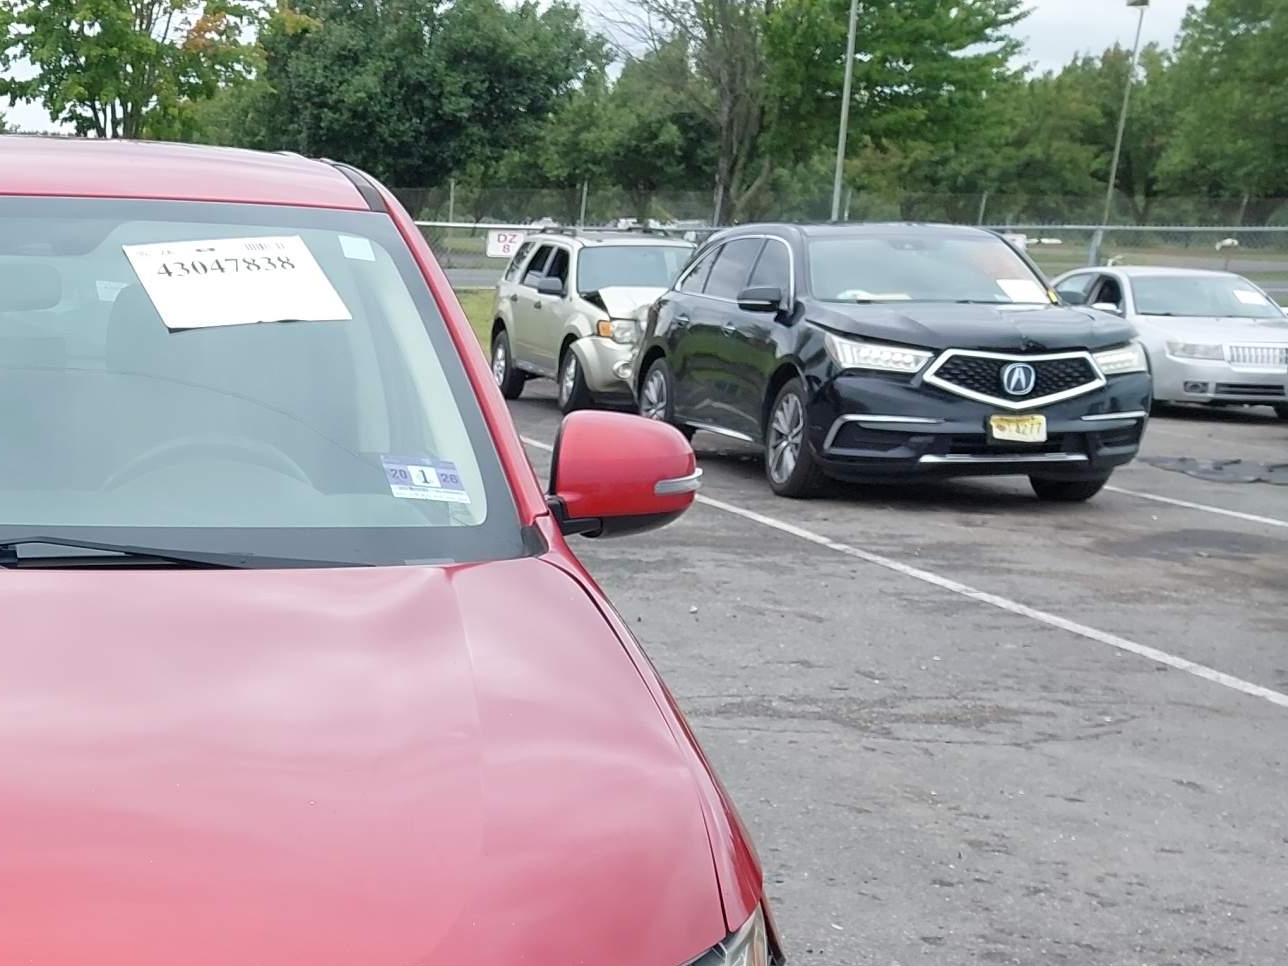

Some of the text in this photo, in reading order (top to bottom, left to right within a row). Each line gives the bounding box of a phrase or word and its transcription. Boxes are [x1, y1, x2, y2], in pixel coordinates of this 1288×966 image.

[158, 256, 295, 277] 43047838
[390, 468, 408, 480] 20
[419, 469, 430, 484] 1
